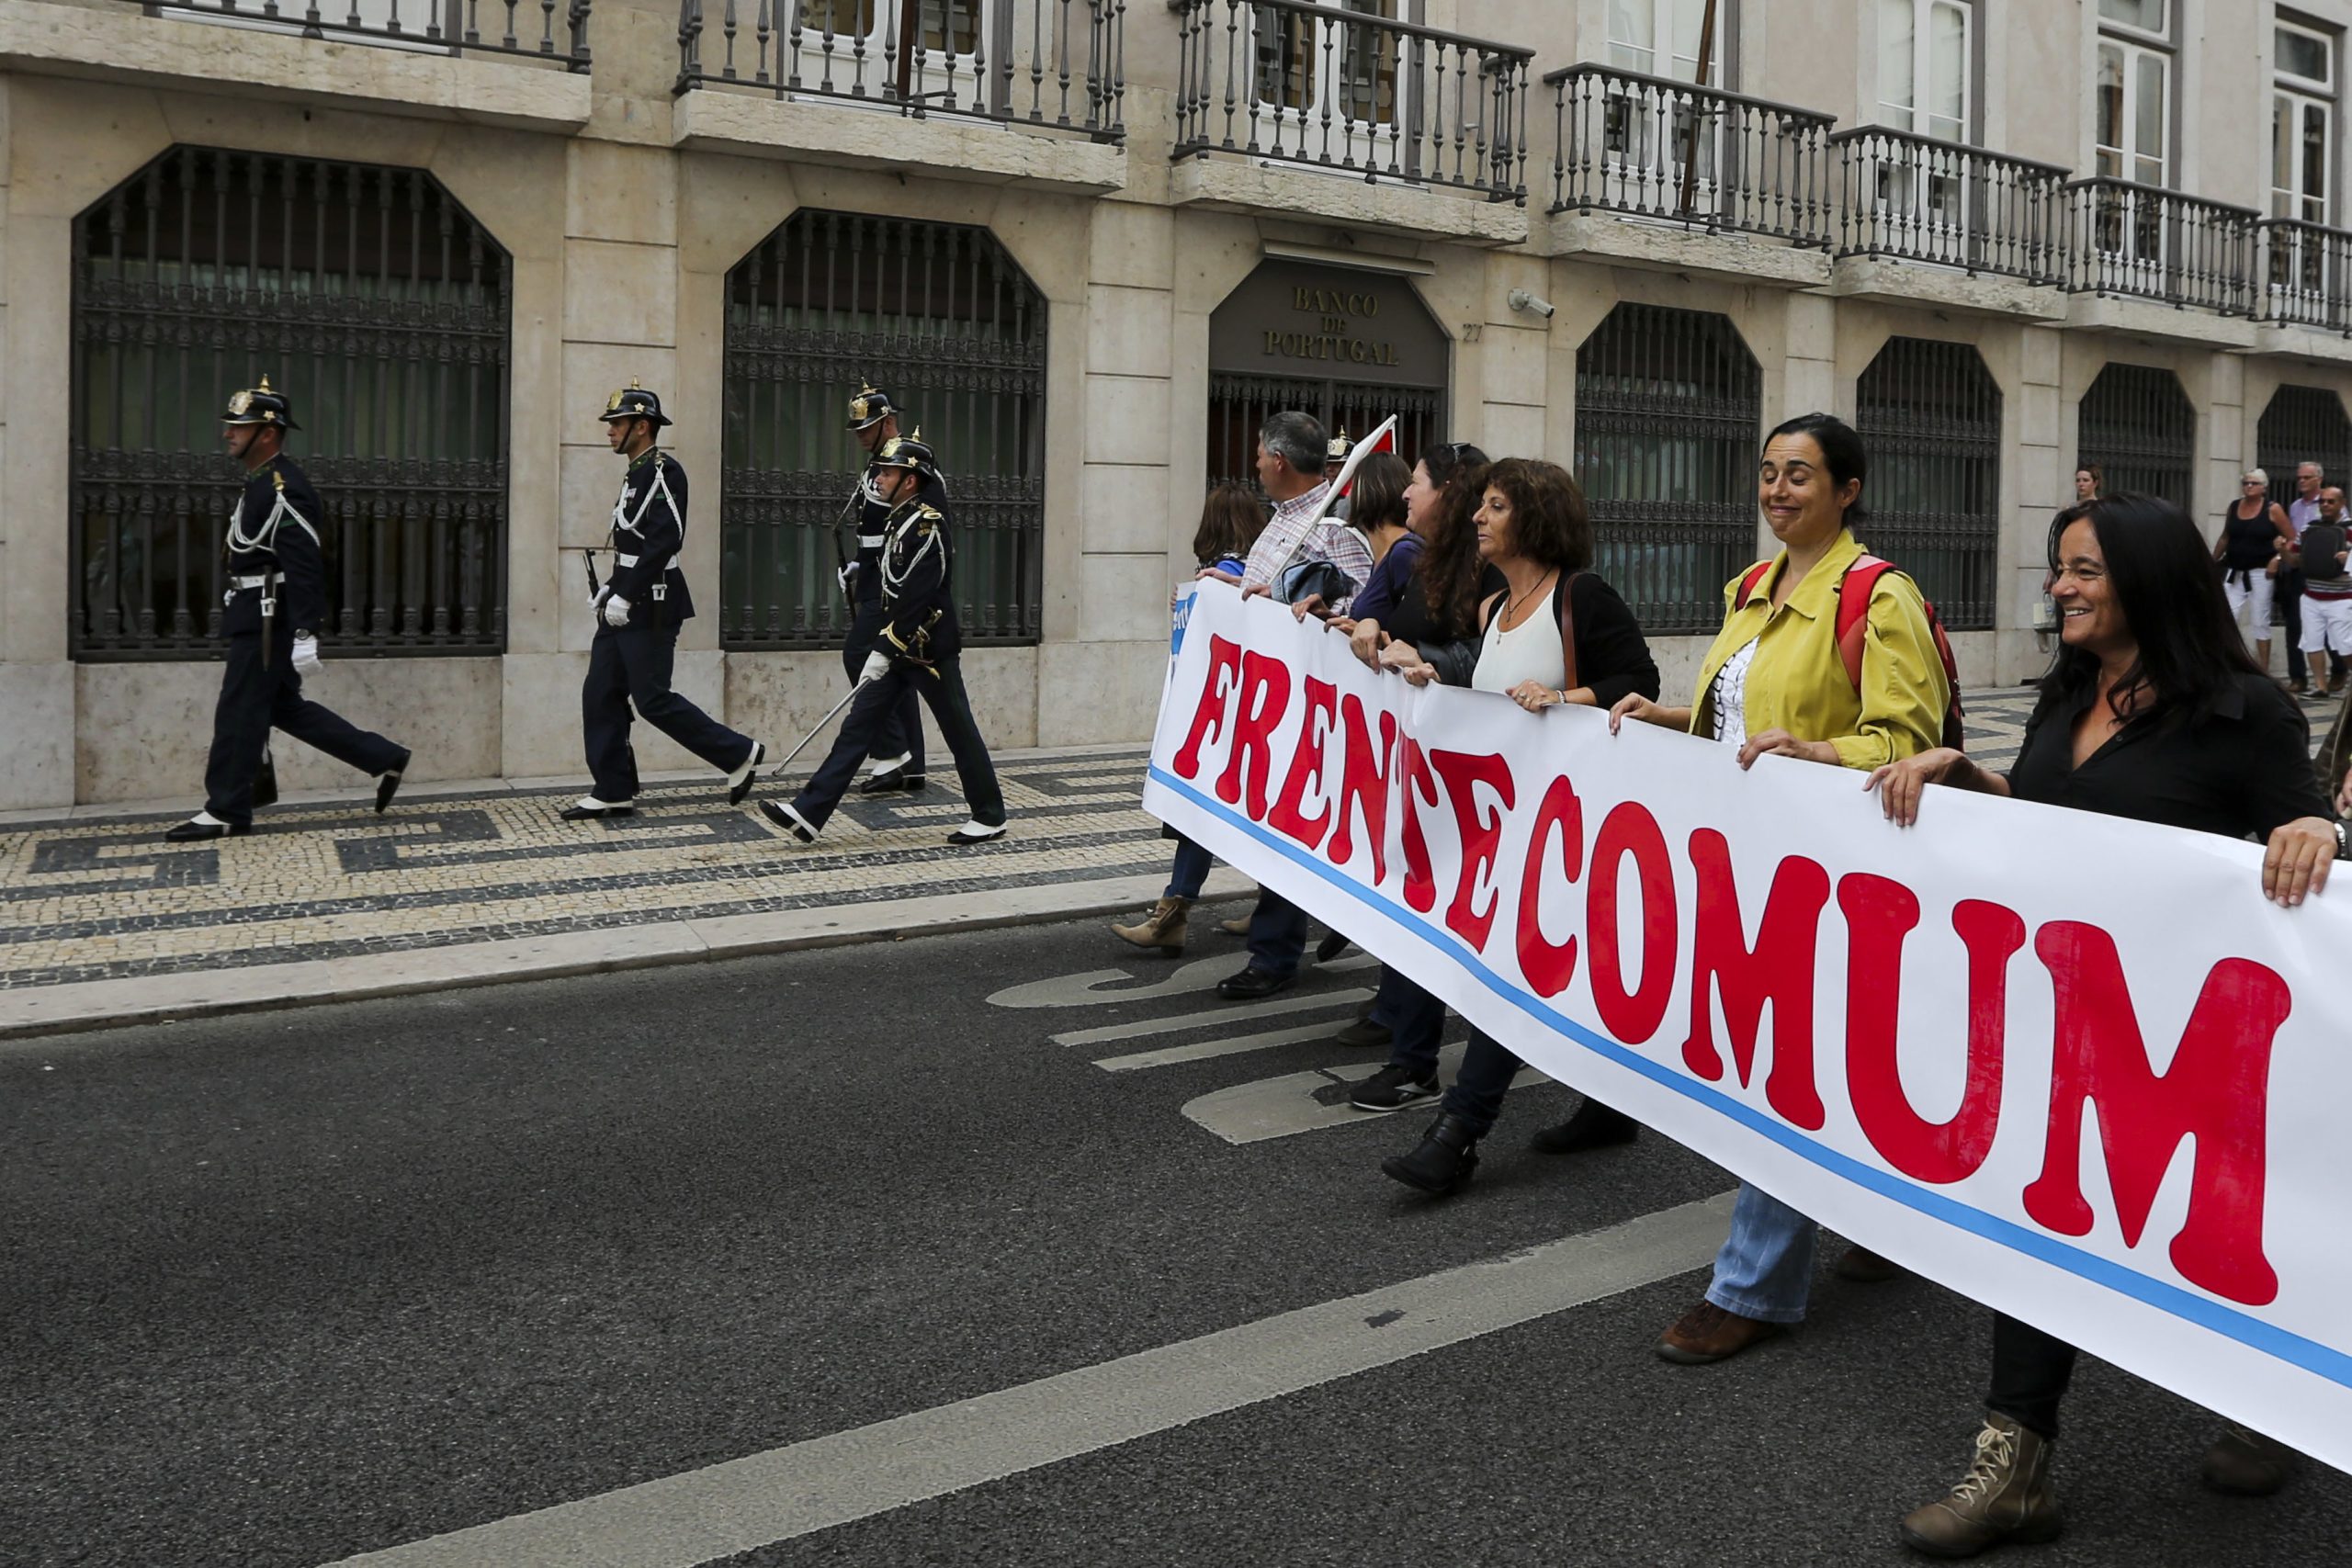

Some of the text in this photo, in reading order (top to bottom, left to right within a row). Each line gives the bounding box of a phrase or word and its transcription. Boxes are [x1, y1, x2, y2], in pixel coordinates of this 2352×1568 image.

[1293, 287, 1378, 318] BANCO
[1321, 317, 1346, 334] DE
[1463, 323, 1483, 343] 27
[1262, 331, 1399, 367] PORTUGAL
[1173, 633, 2291, 1305] FRENTE COMUM
